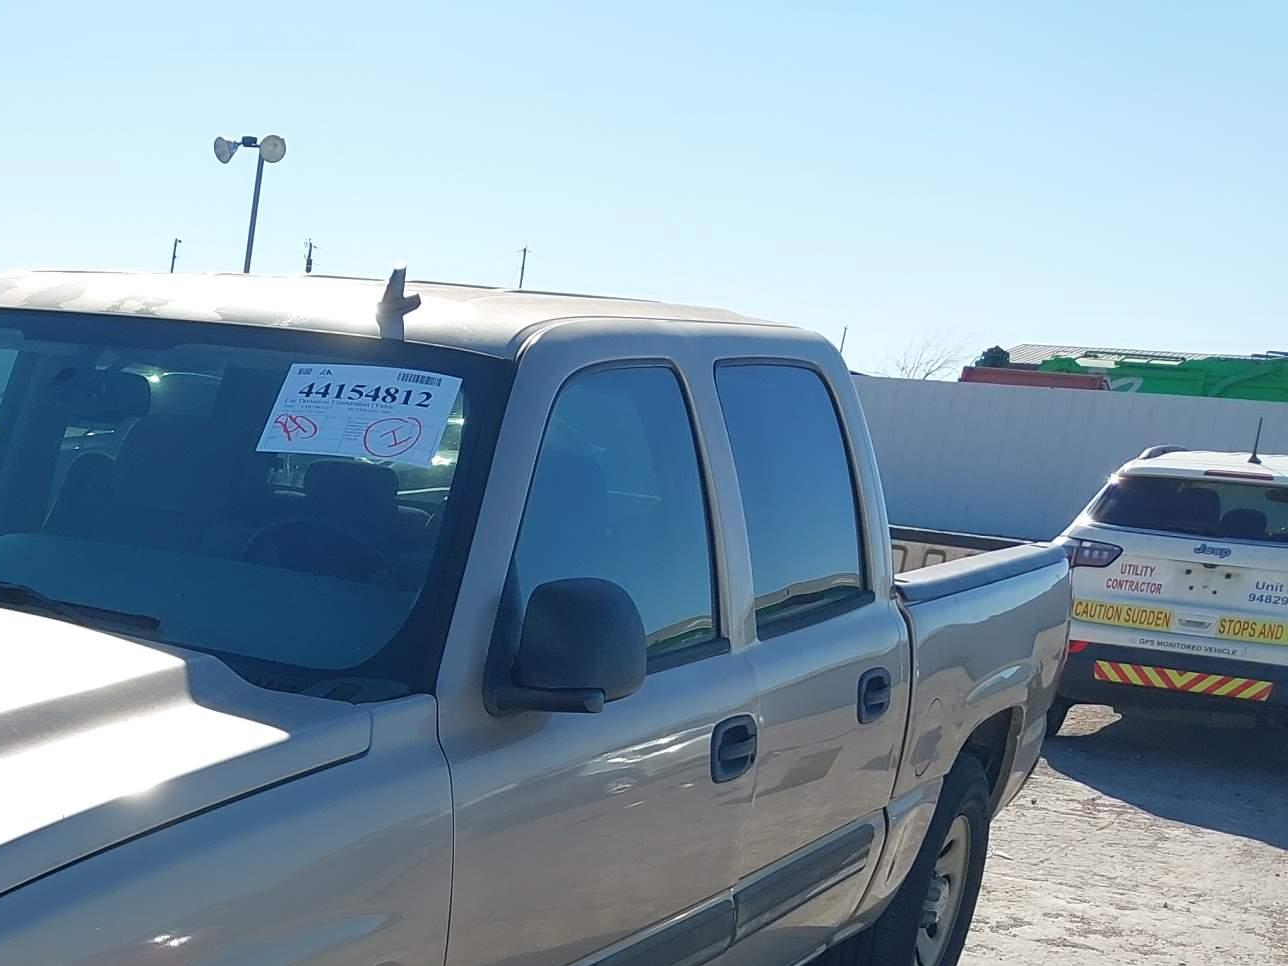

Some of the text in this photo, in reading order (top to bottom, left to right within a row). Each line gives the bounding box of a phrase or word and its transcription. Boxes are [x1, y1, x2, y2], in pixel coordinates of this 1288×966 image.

[298, 382, 433, 408] 44154812
[1193, 543, 1232, 558] Jeep
[1120, 563, 1156, 577] UTILITY
[1106, 578, 1162, 595] CONTRACTOR
[1255, 580, 1284, 592] Unit
[1074, 601, 1284, 640] CAUTION SUDDEN STOPS AND
[1139, 638, 1239, 657] GPS MONITORED VEHICLE
